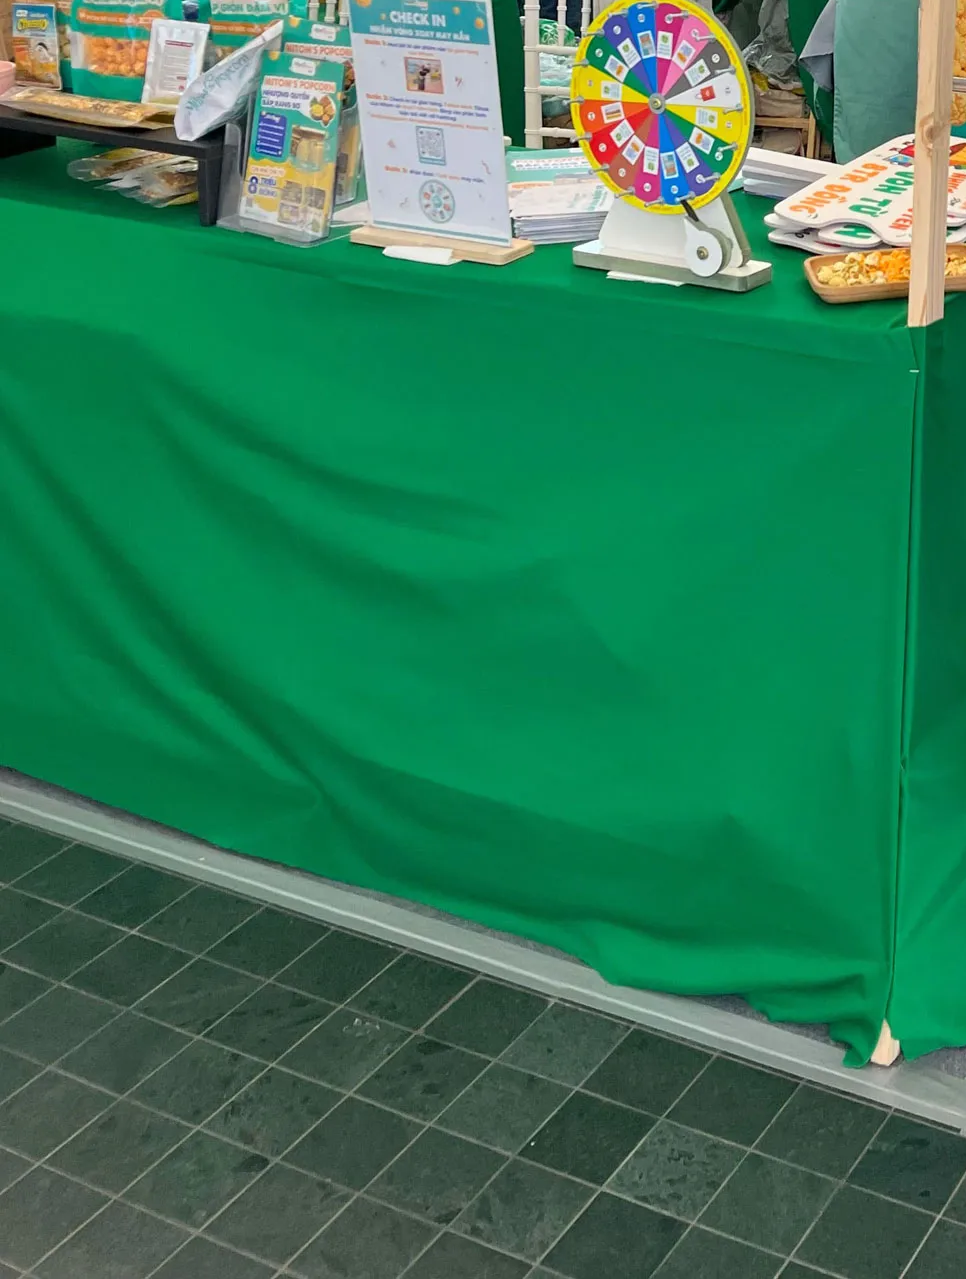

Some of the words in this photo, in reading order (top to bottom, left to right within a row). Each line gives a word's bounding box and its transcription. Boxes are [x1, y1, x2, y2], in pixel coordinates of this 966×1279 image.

[390, 10, 430, 26] CHECK
[431, 14, 446, 27] IN
[299, 80, 335, 93] POPCORN
[248, 176, 259, 195] 8
